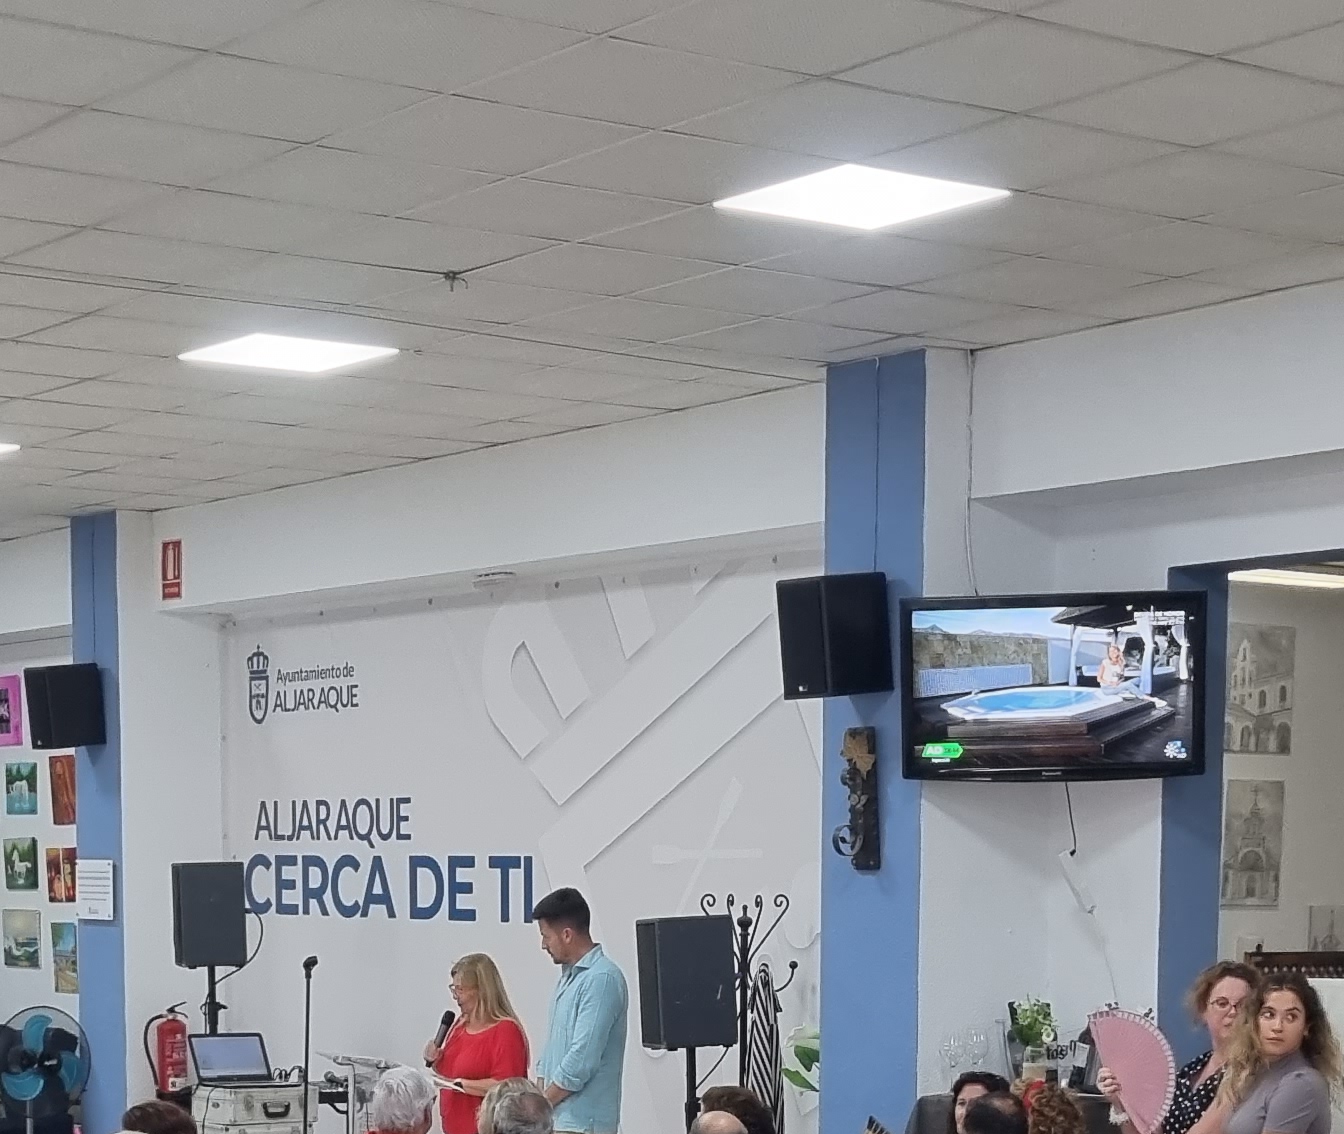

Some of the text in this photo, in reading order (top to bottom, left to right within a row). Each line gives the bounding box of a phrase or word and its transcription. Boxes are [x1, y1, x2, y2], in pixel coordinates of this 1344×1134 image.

[276, 661, 355, 686] Ayuntamiento de
[272, 684, 360, 713] ALJARAQUE
[254, 797, 412, 849] ALJARAQUE
[245, 853, 534, 924] CERCA DE TI
